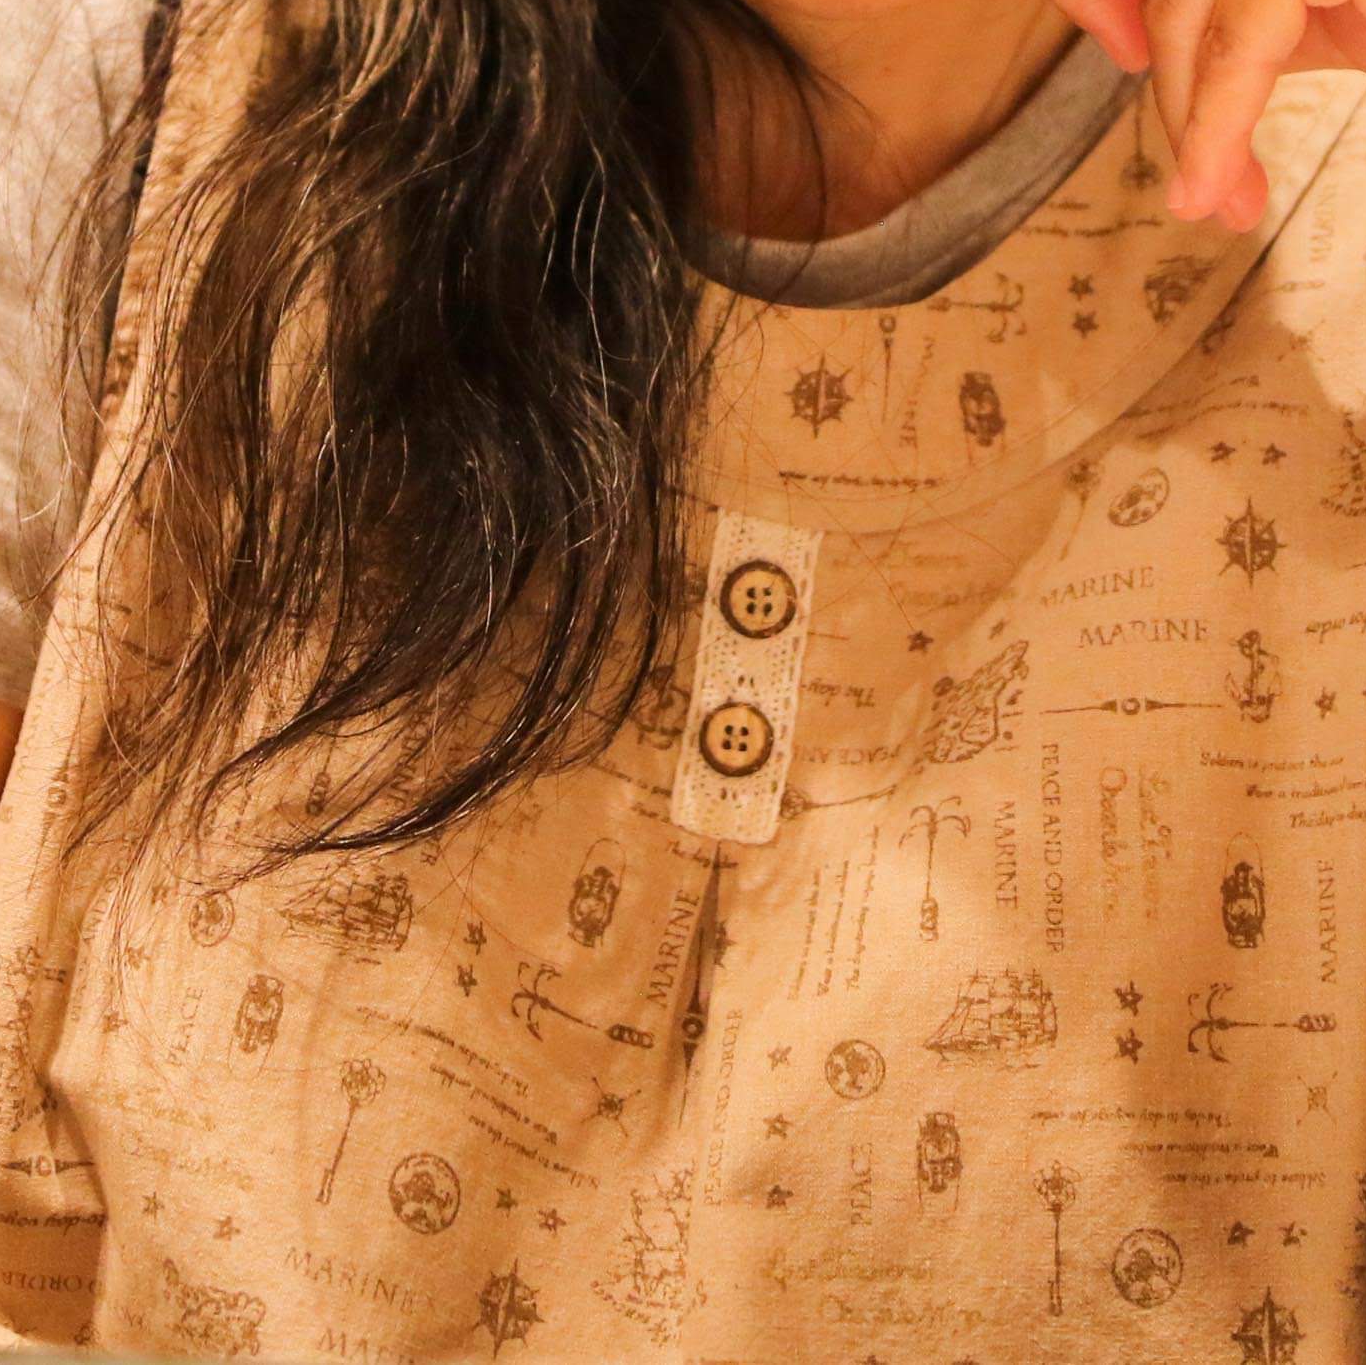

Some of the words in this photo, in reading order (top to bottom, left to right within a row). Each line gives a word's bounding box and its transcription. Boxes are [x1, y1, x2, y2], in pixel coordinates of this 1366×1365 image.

[1079, 618, 1209, 649] MARINE
[1041, 743, 1062, 806] PEACE
[994, 801, 1018, 910] MARINE
[645, 889, 700, 1010] MARINE
[1316, 859, 1335, 983] MARINE
[284, 1246, 419, 1316] MARINE
